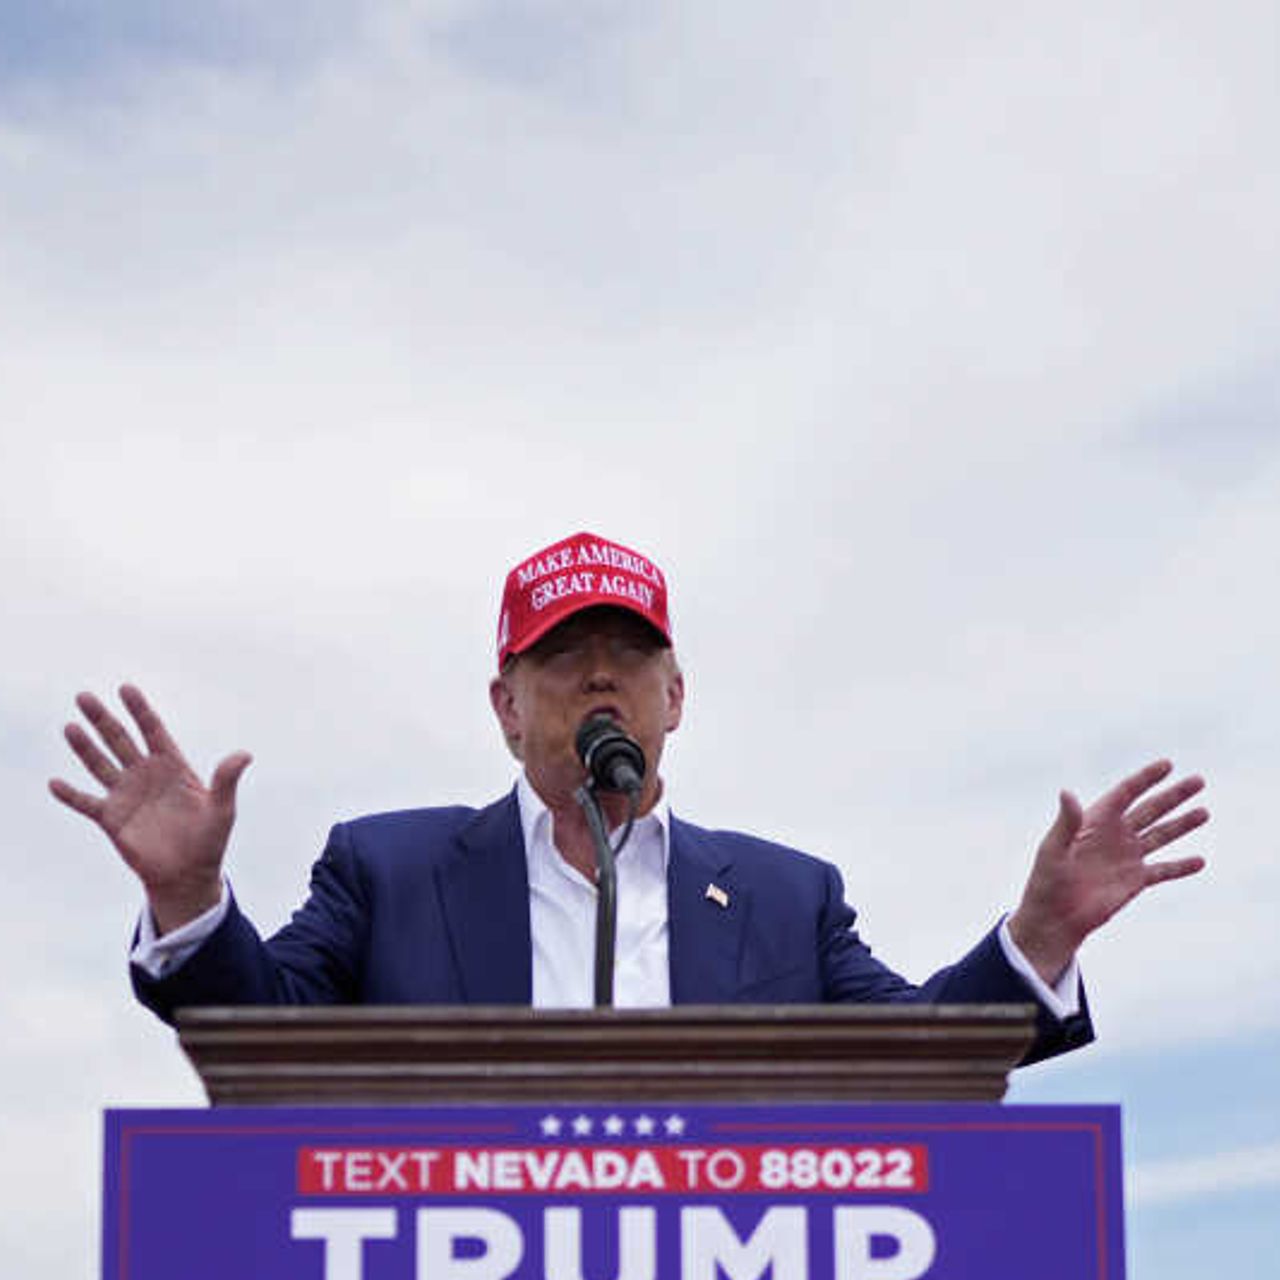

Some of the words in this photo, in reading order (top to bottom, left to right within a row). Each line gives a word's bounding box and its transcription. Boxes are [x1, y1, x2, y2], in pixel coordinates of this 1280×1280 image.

[517, 547, 574, 587] MAKE
[577, 542, 663, 587] AMERICA
[531, 571, 594, 610] GREAT
[598, 574, 654, 609] AGAIN
[314, 1151, 439, 1190] TEXT
[454, 1150, 665, 1190] NEVADA
[678, 1150, 745, 1189] TO
[759, 1149, 914, 1189] 88022
